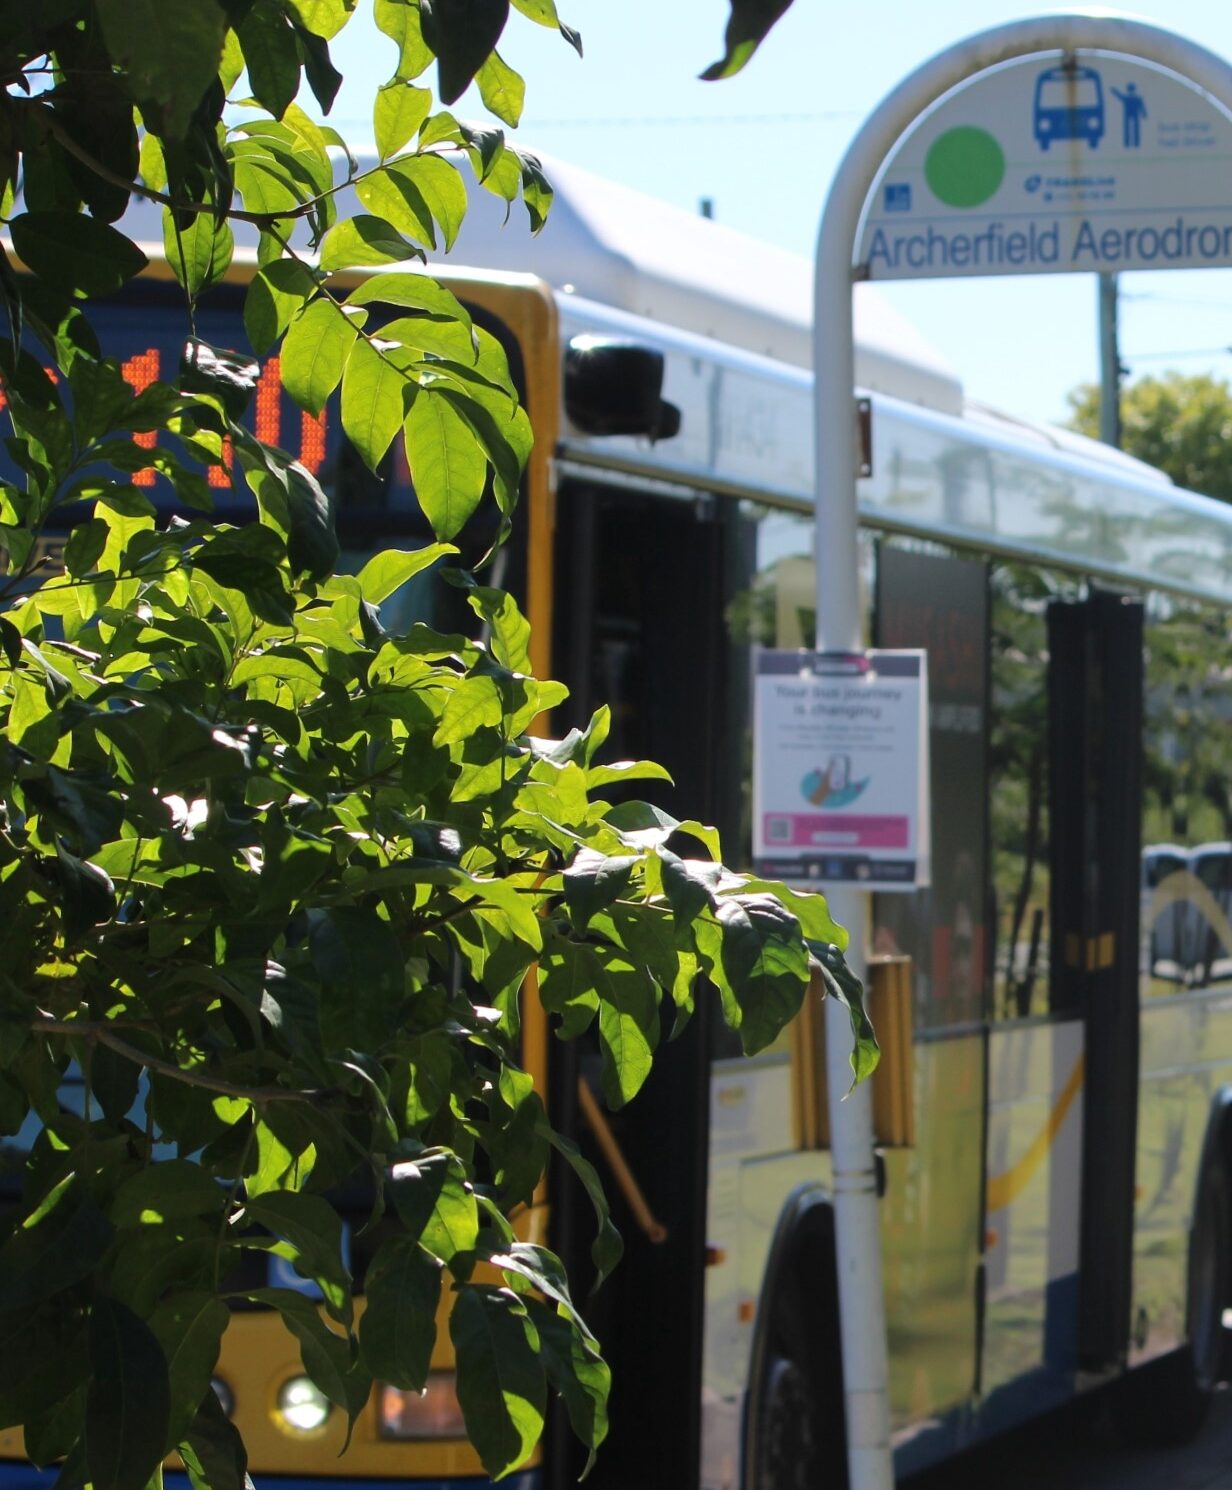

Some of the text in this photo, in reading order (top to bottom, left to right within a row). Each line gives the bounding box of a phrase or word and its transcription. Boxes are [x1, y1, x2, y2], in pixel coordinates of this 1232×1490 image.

[867, 222, 1060, 270] Archerfield
[775, 684, 806, 699] Your
[843, 686, 903, 702] journey
[810, 703, 883, 720] changing
